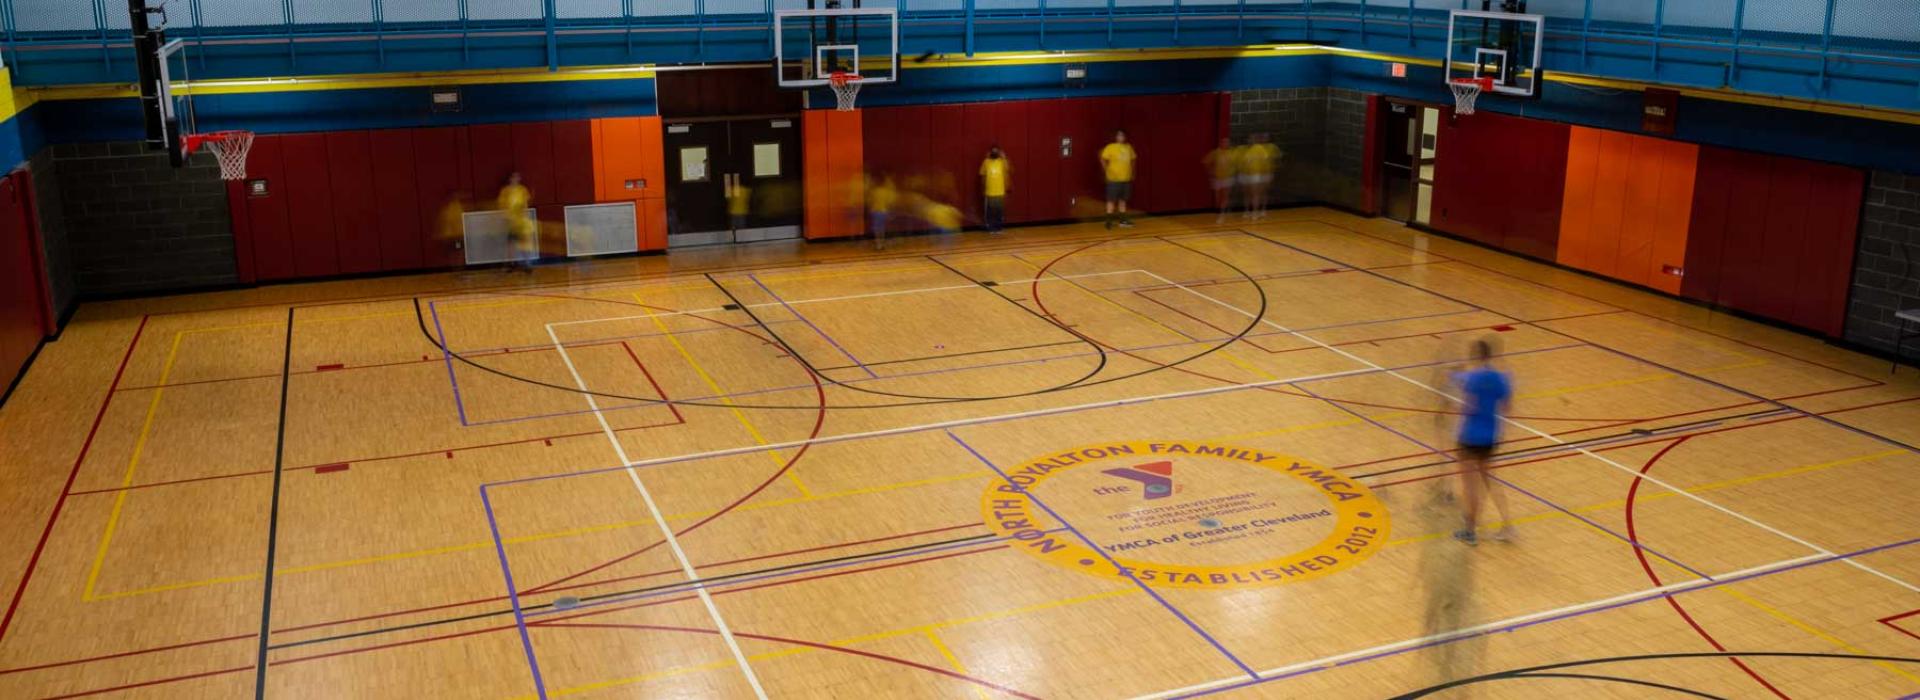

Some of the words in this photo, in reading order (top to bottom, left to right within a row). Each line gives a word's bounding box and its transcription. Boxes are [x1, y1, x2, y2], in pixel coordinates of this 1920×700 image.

[997, 444, 1135, 494] ROYALTON
[1149, 443, 1278, 463] FAMILY
[1093, 485, 1131, 496] the
[1100, 460, 1172, 499] Y
[1286, 462, 1364, 502] YMCA
[1107, 511, 1132, 520] FOR
[1136, 505, 1175, 517] YOUTH
[1176, 493, 1257, 510] DEVELOPMENT
[1119, 522, 1143, 532] FOR
[1145, 516, 1184, 528] SOCIAL
[1186, 502, 1276, 520] RESPONSIBILITY
[1132, 513, 1156, 522] FOR
[1158, 506, 1209, 519] HEALTHY
[1211, 500, 1250, 509] LIVING
[993, 499, 1067, 554] NORTH
[1104, 538, 1160, 552] YMCA
[1163, 534, 1181, 544] of
[1183, 523, 1249, 539] Greater
[1250, 509, 1332, 528] Cleveland
[1189, 533, 1248, 546] Established
[1117, 554, 1339, 584] ESTABLISHED
[1335, 526, 1378, 555] 2012
